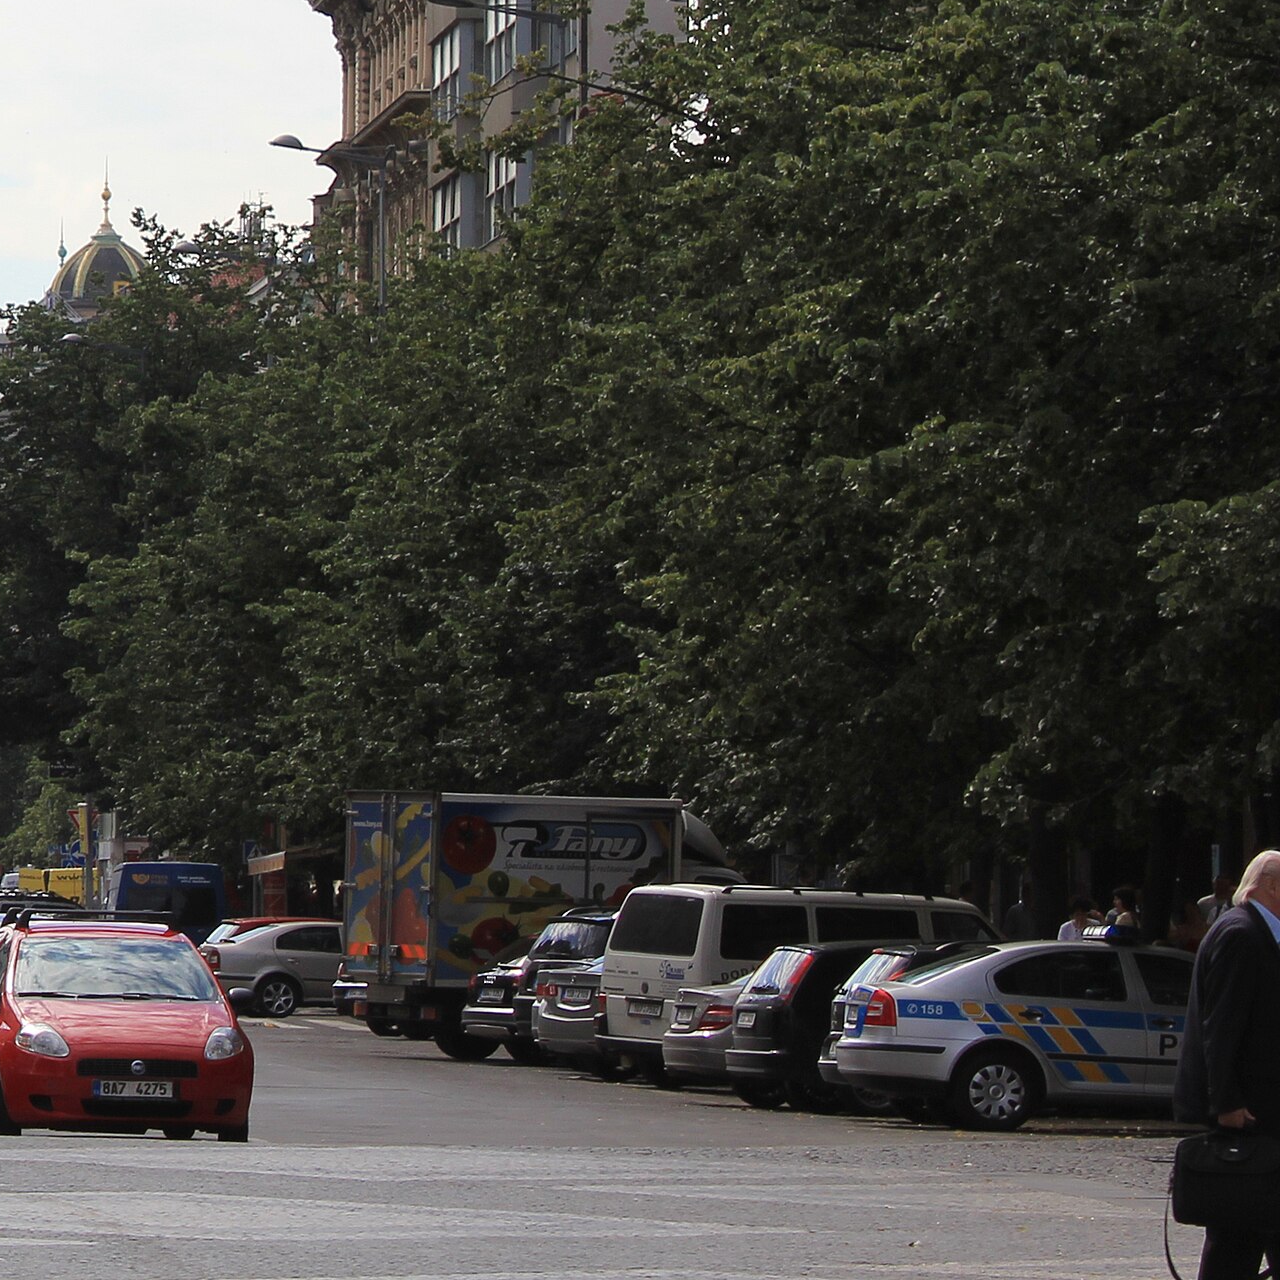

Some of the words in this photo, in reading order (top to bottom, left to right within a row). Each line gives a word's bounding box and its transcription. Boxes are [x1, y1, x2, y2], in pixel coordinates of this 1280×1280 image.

[921, 1005, 943, 1015] 158
[102, 1082, 126, 1094] 8A7
[136, 1083, 167, 1095] 4275
